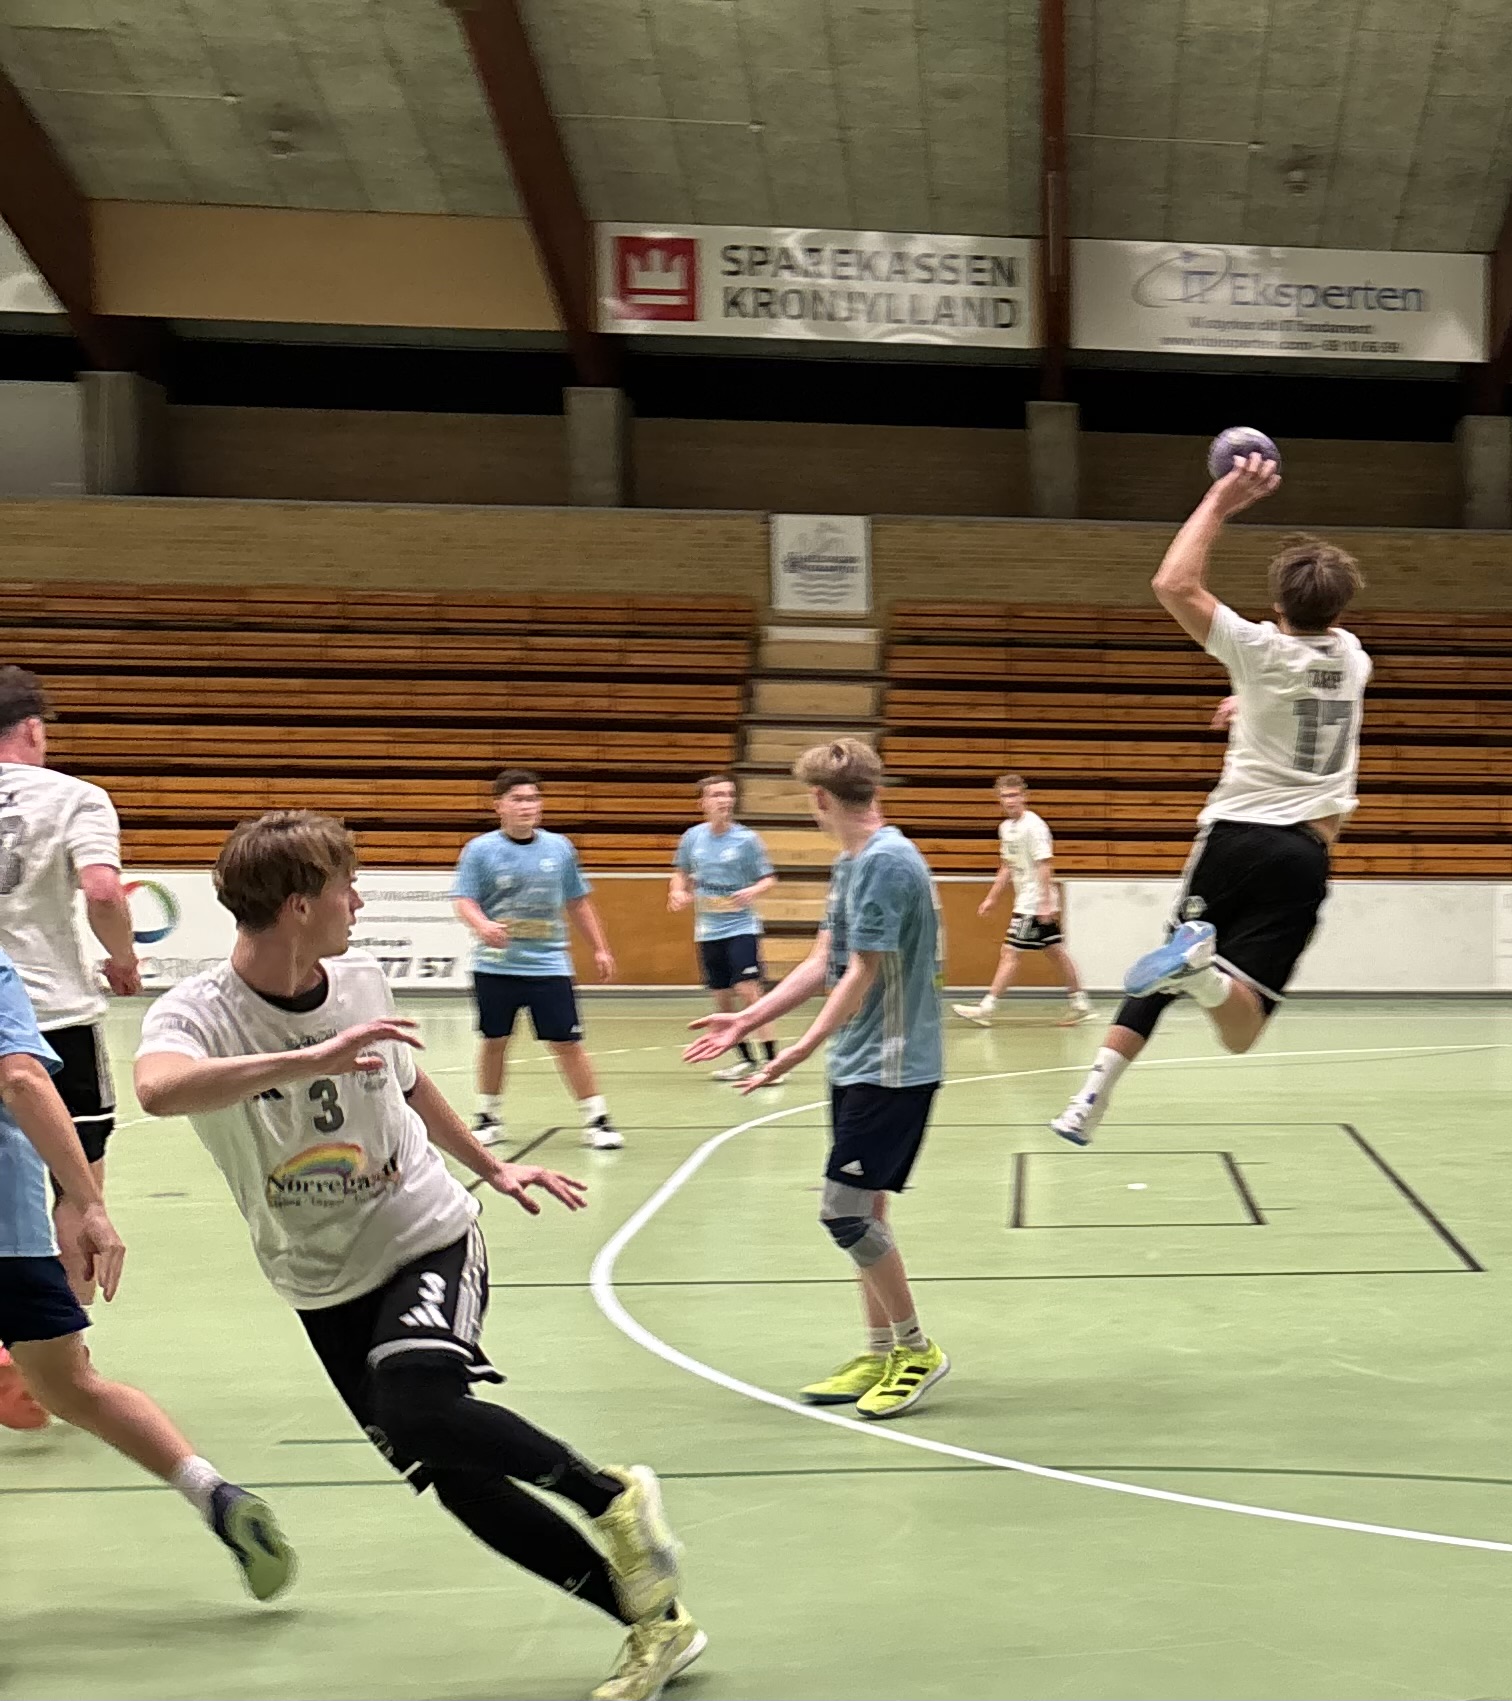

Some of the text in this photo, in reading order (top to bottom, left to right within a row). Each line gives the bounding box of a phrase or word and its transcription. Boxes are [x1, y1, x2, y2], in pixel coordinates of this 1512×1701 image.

[719, 243, 1021, 288] SPAREKASSEN
[720, 285, 1019, 329] KRONJYLLAND
[1228, 271, 1426, 318] Eksperten
[1292, 699, 1353, 776] 17
[416, 956, 457, 979] 57
[309, 1078, 345, 1133] 3
